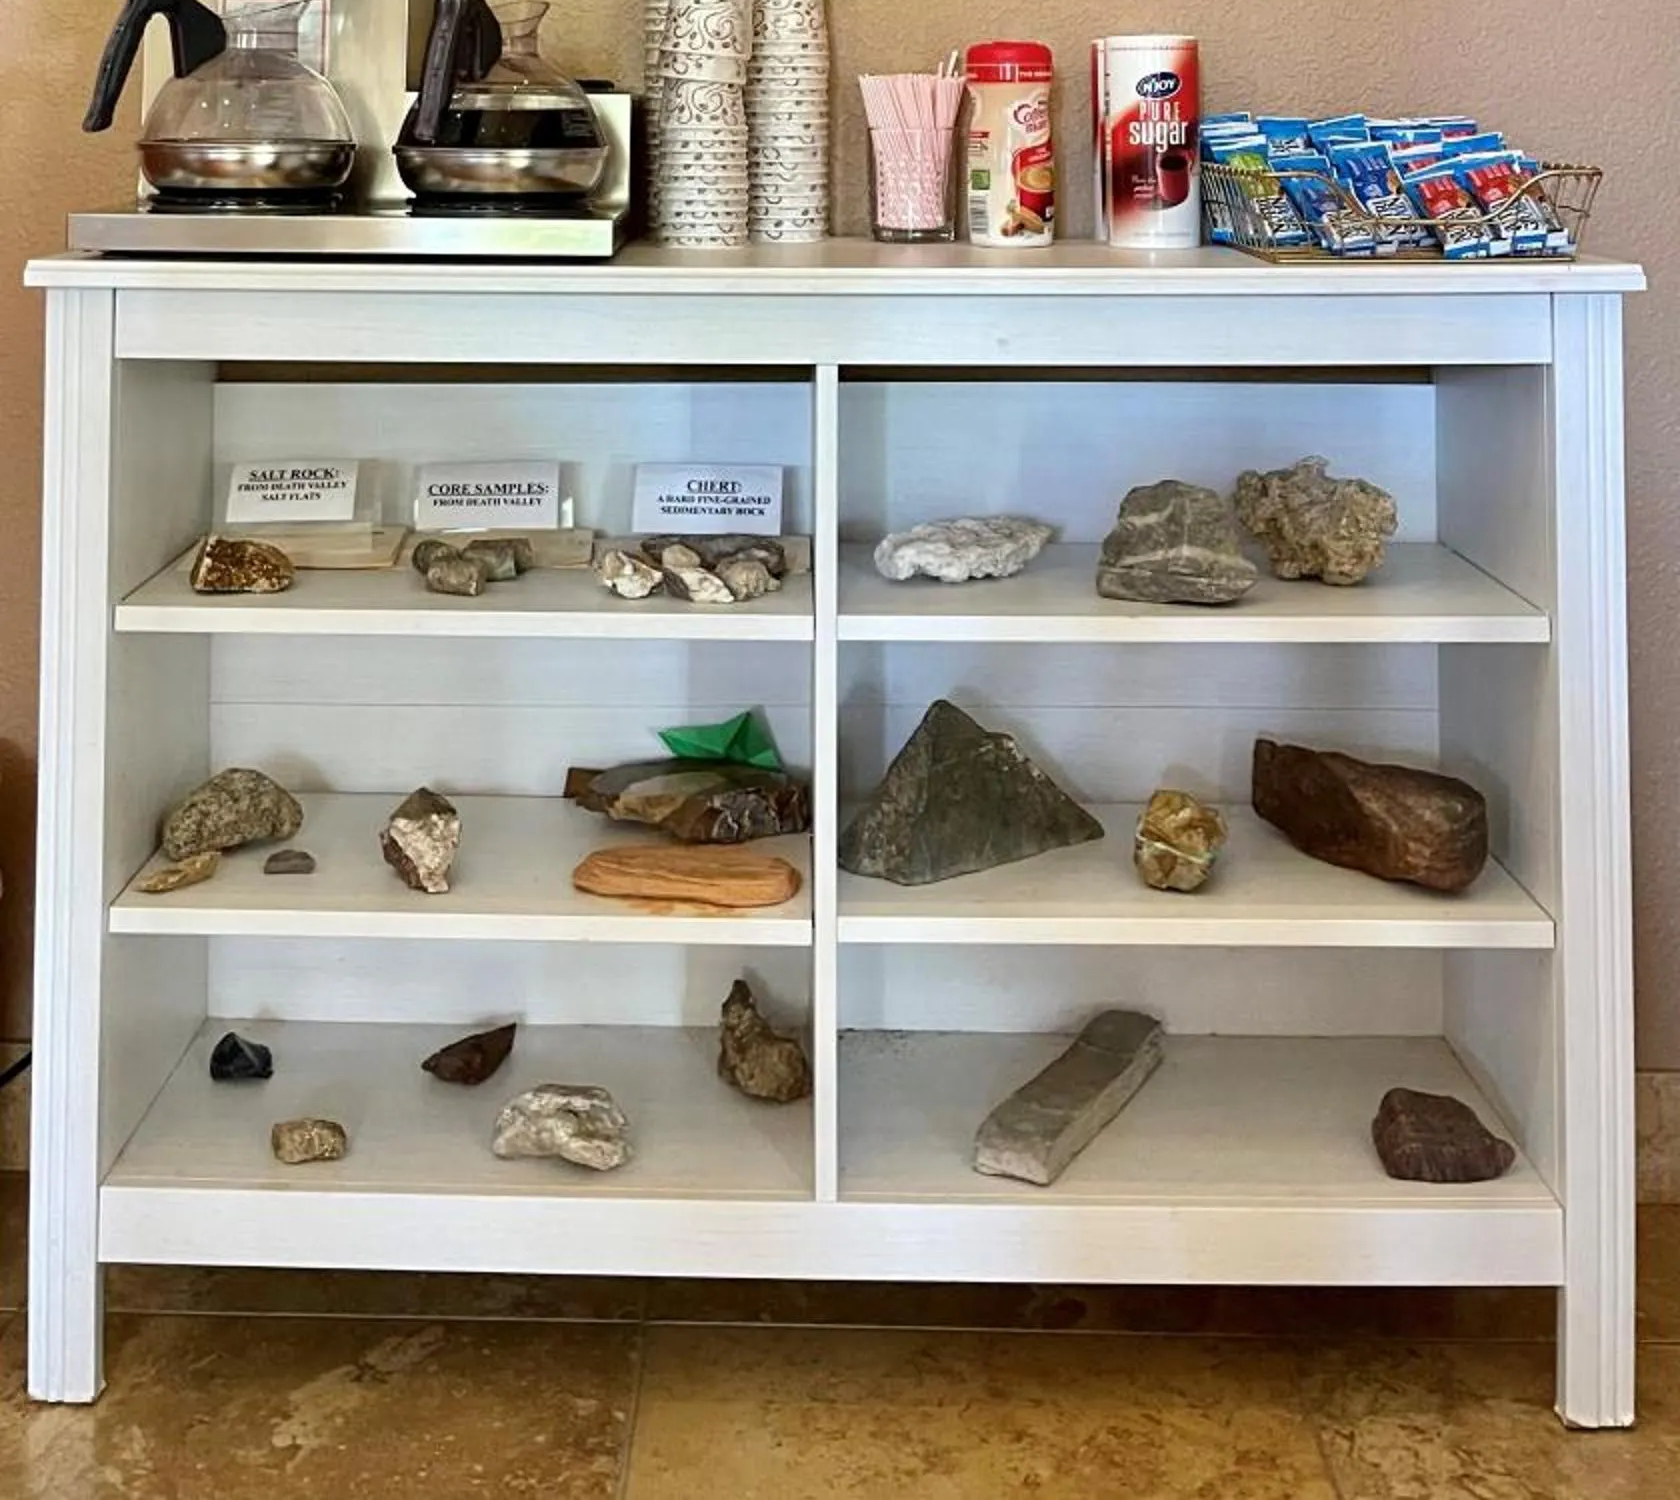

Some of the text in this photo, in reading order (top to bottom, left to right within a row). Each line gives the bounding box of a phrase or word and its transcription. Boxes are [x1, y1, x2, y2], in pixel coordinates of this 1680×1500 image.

[1140, 101, 1181, 121] PURE
[1129, 121, 1188, 153] sugar
[249, 469, 287, 481] SALT
[238, 481, 347, 492] FROM DEATH VALLEY
[428, 482, 549, 496] CORE SAMPLES:
[261, 492, 321, 501] SALT FLATS
[433, 497, 542, 507] FROM DEATH VALLEY
[697, 495, 772, 505] FINE-GRAINED
[660, 505, 766, 516] SEDIMENTARY ROCK
